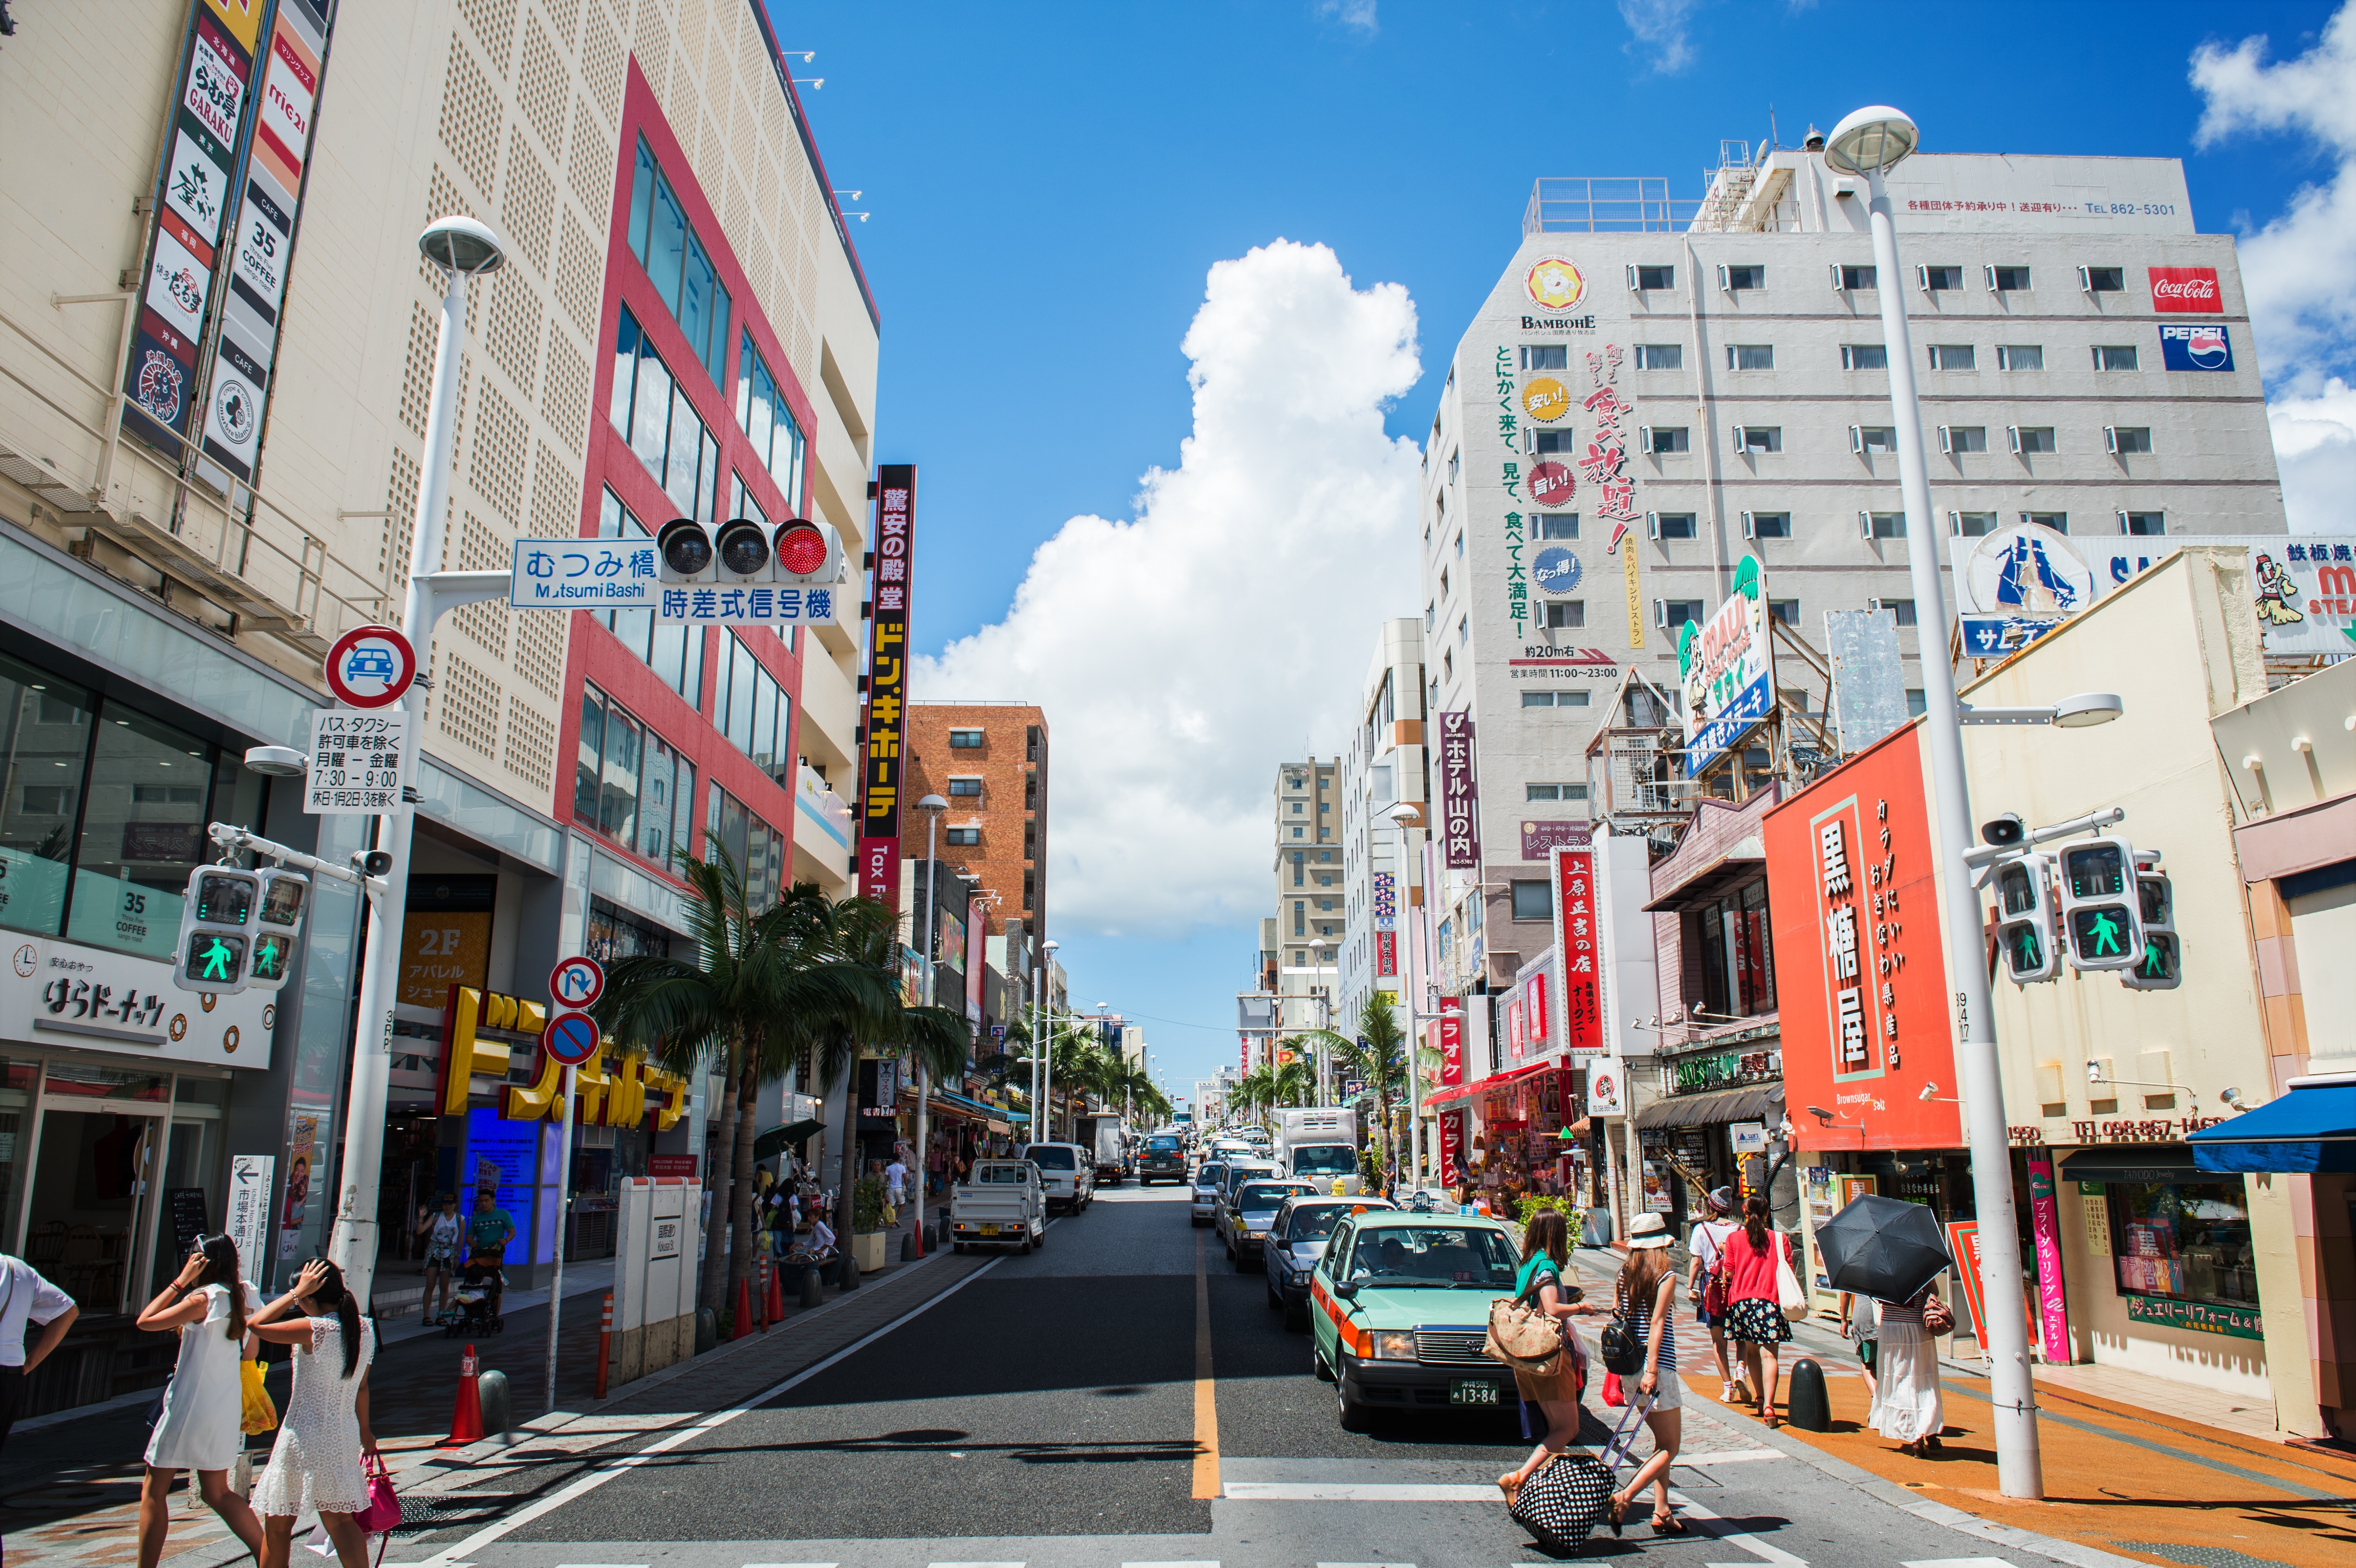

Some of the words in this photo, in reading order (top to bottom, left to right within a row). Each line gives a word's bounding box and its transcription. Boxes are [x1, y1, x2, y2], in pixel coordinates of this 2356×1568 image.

[213, 36, 235, 66] 北海道
[282, 44, 310, 84] マリングッズ
[190, 88, 233, 143] GARAKU
[269, 84, 306, 135] mic21
[199, 133, 214, 154] 東京
[261, 198, 279, 221] CAFE
[2110, 203, 2175, 216] 862-5301
[181, 229, 197, 249] 福岡
[252, 221, 276, 258] 35
[249, 243, 263, 262] Three
[263, 258, 274, 272] Five
[1525, 255, 1554, 279] YAKINIKU
[1555, 254, 1586, 277] STATION
[243, 250, 276, 289] COFFEE
[244, 264, 259, 284] sango
[259, 279, 272, 295] roast
[2153, 277, 2216, 299] Coca-Cola
[1535, 301, 1579, 313] BAMBOHE
[1521, 315, 1596, 329] BAMBOHE
[162, 329, 178, 349] 沖縄
[2162, 327, 2223, 341] PEPSI
[234, 354, 253, 375] CAFE
[1528, 386, 1563, 412] 安い!
[1534, 469, 1569, 497] 旨い!
[879, 488, 908, 610] 驚安の殿堂
[2286, 543, 2356, 562] 鉄板焼
[525, 549, 655, 579] むつみ橋
[1536, 557, 1576, 582] なっ得!
[605, 581, 645, 599] Bashi
[1625, 537, 1642, 645] 焼肉&バイキングレストラン
[662, 588, 832, 621] 時差式信号機
[1703, 592, 1748, 665] MAUI
[1525, 645, 1575, 658] 約20m右
[1705, 655, 1726, 686] STEAK
[1726, 631, 1751, 669] HOUSE
[1510, 668, 1548, 679] 営業時間
[1712, 657, 1745, 708] マウイ
[319, 716, 401, 733] バス・タクシー
[318, 734, 401, 751] 許可車を除く
[316, 752, 345, 768] 月曜
[370, 752, 399, 769] 金曜
[315, 770, 346, 787] 7:30
[365, 770, 397, 787] 9:00
[1446, 740, 1471, 857] ホテル山の内
[1526, 836, 1591, 849] レストラン
[871, 845, 888, 879] Tax
[1374, 874, 1392, 886] カラオケ
[1876, 798, 1905, 971] カラダにいい
[124, 892, 146, 914] 35
[1374, 888, 1392, 901] カラオケ
[121, 914, 134, 923] Three
[134, 916, 144, 925] Five
[1374, 903, 1392, 915] カラオケ
[1566, 860, 1592, 973] 上原正吉の店
[116, 921, 147, 936] COFFEE
[117, 933, 131, 942] sango
[131, 935, 143, 944] roast
[418, 929, 460, 956] 2F
[1821, 819, 1866, 1064] 黒糖屋
[51, 956, 93, 972] 安心おやつ
[1382, 933, 1392, 975] 御菓子御殿
[1870, 864, 1900, 1065] おきなわ県産品
[409, 965, 465, 979] アパレル
[45, 977, 166, 1028] はらドーナッツ
[407, 985, 448, 998] シュー
[1442, 1004, 1461, 1078] カラオケ
[881, 1078, 889, 1104] マスケラ
[1836, 1092, 1871, 1106] Brownsugar
[1873, 1100, 1885, 1111] salt
[2123, 1170, 2154, 1180] TAIYODO
[2156, 1169, 2175, 1179] Jewelry
[250, 1188, 258, 1208] Ichiba
[1414, 1193, 1428, 1207] 沖縄
[234, 1188, 251, 1249] 市場本通り
[657, 1240, 671, 1252] Kokusai
[2036, 1199, 2056, 1297] ブライダルリング
[1455, 1271, 1470, 1281] 空車
[2048, 1315, 2059, 1350] エテルノ
[1463, 1388, 1496, 1403] 13-84
